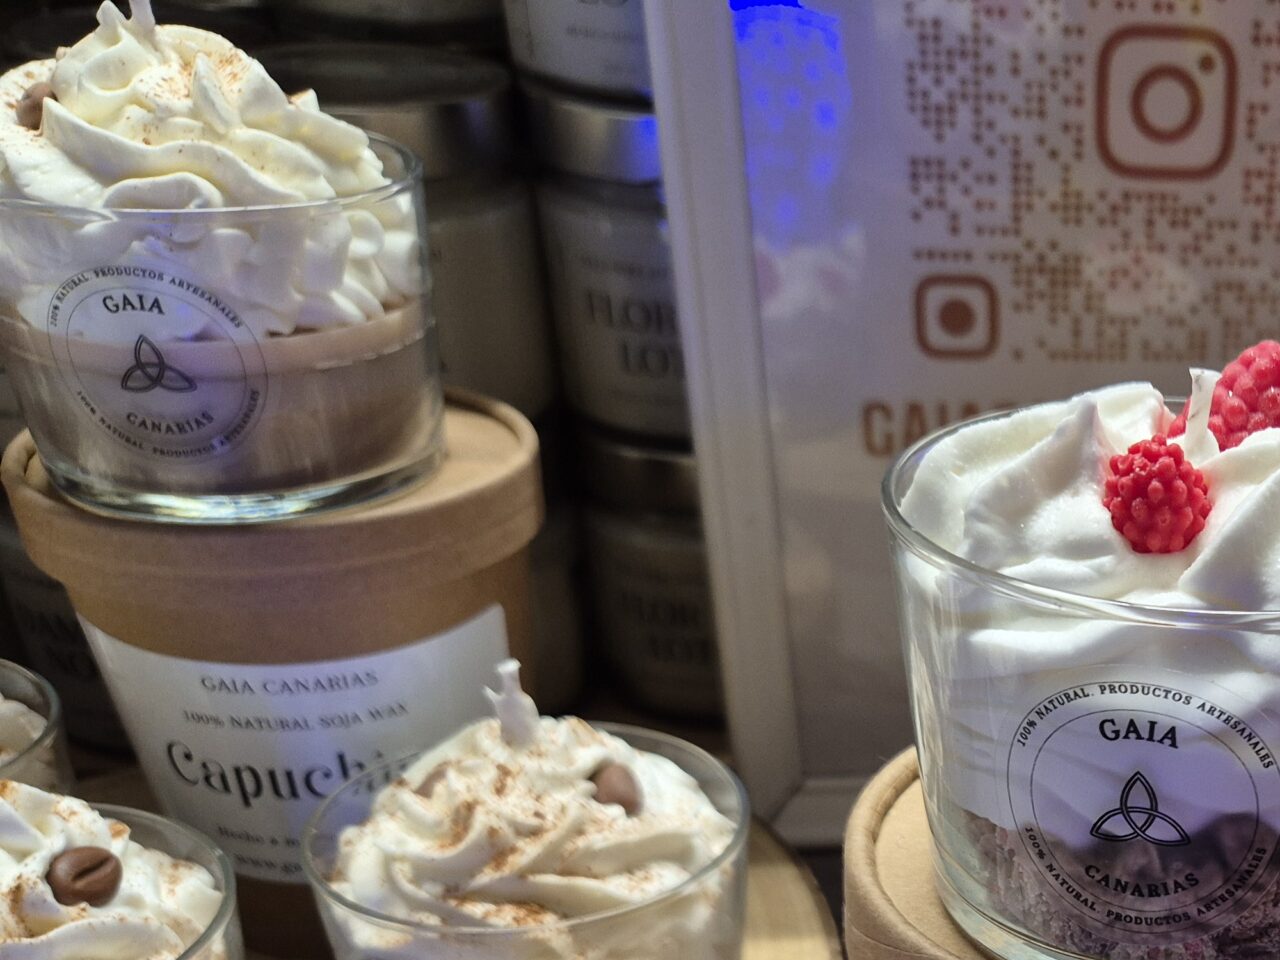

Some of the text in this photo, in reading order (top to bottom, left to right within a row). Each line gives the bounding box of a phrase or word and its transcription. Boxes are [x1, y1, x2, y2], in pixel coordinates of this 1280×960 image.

[102, 293, 166, 316] GAIA
[126, 411, 215, 436] CANARIAS
[201, 671, 379, 696] GAIA CANARIAS
[182, 709, 225, 729] 100%
[228, 714, 313, 732] NATURAL
[1016, 719, 1038, 748] 100%
[1098, 684, 1193, 706] PRODUCTOS
[1196, 701, 1275, 770] ARTESANALES
[1098, 718, 1179, 750] GAIA
[1024, 826, 1047, 861] 100%
[1105, 909, 1192, 927] PRODUCTOS
[1196, 846, 1267, 916] ARTESANALES
[1084, 864, 1200, 899] CANARIAS
